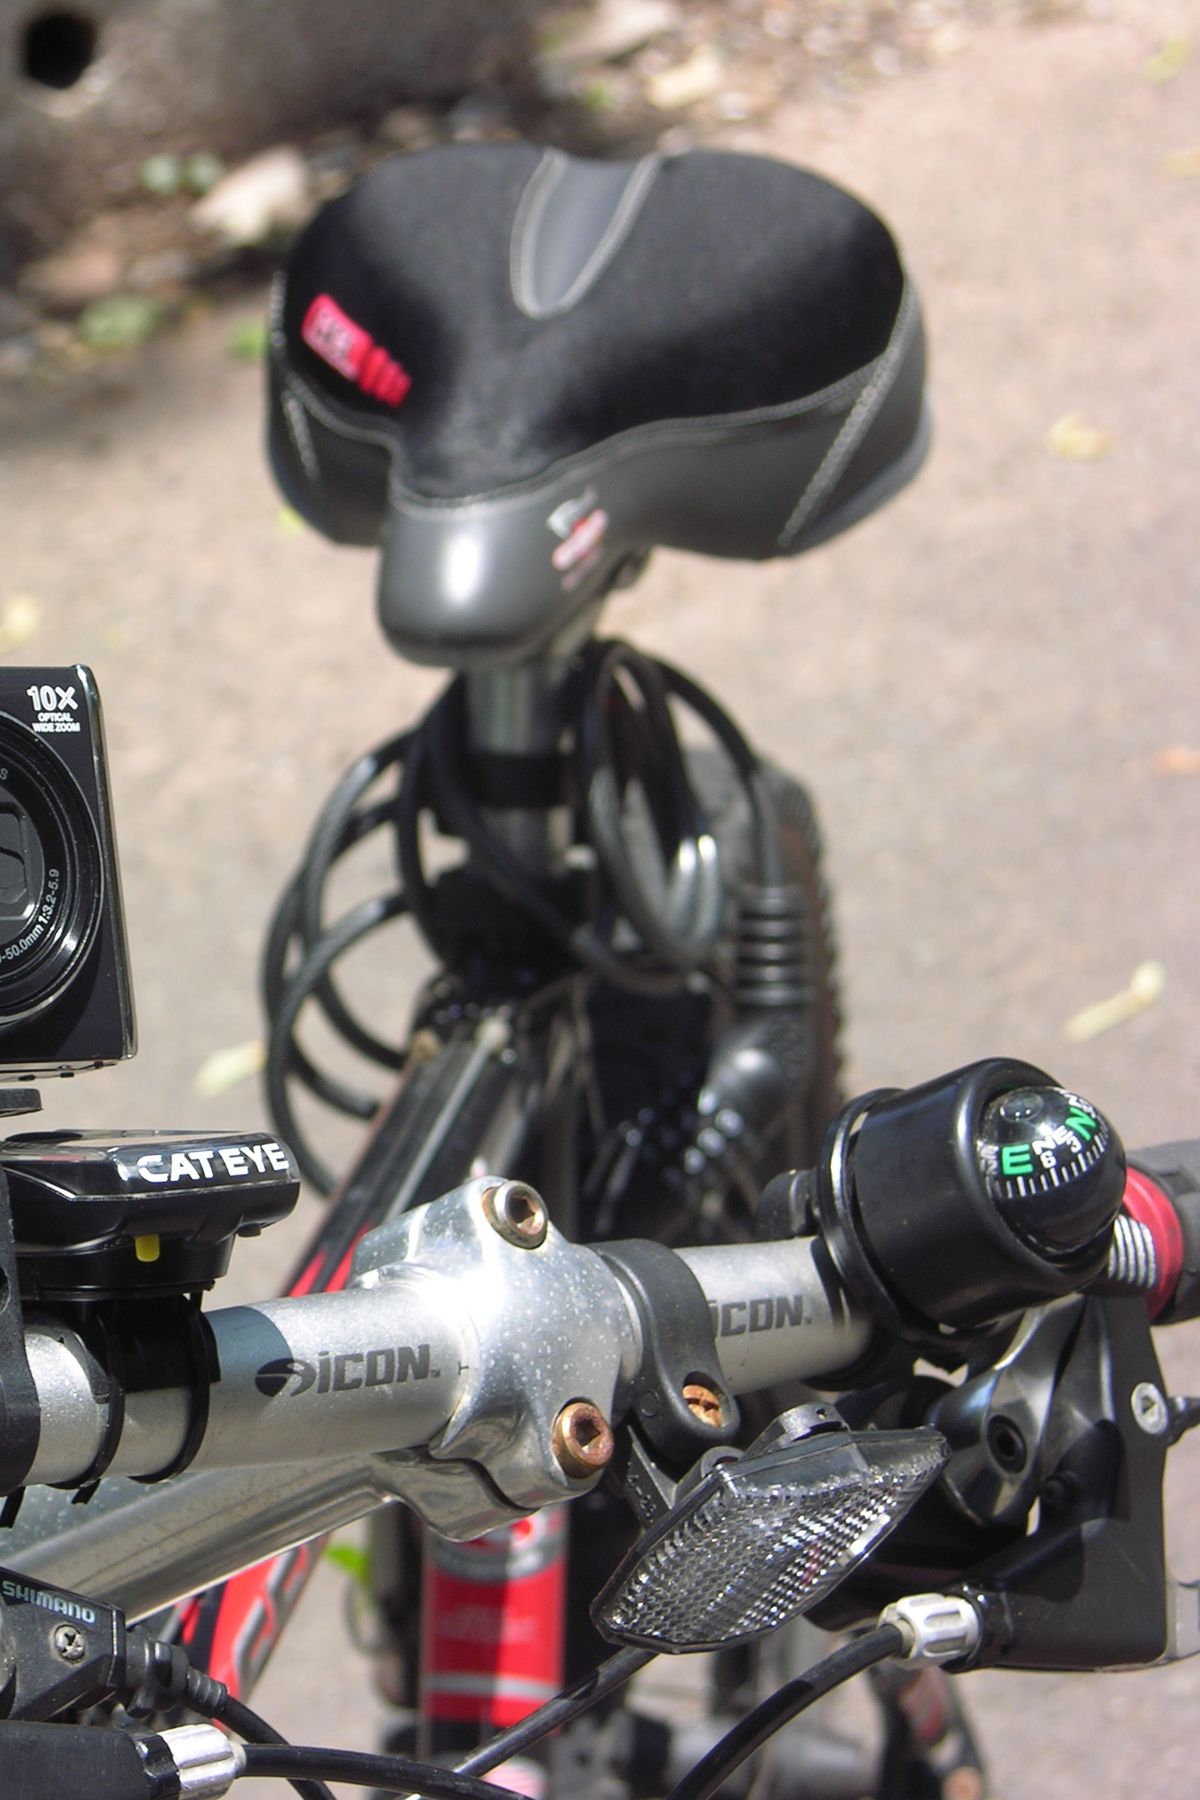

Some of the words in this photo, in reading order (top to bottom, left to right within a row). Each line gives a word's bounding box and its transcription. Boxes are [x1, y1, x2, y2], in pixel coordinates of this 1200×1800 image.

[31, 722, 55, 733] WIDE
[55, 722, 81, 733] ZOOM
[37, 712, 75, 722] OPTICAL
[38, 868, 60, 924] 1:3.2-5.9
[1002, 1144, 1033, 1175] E
[1065, 1107, 1098, 1141] N
[1040, 1150, 1057, 1168] 6
[2, 1580, 96, 1625] SHIMANO
